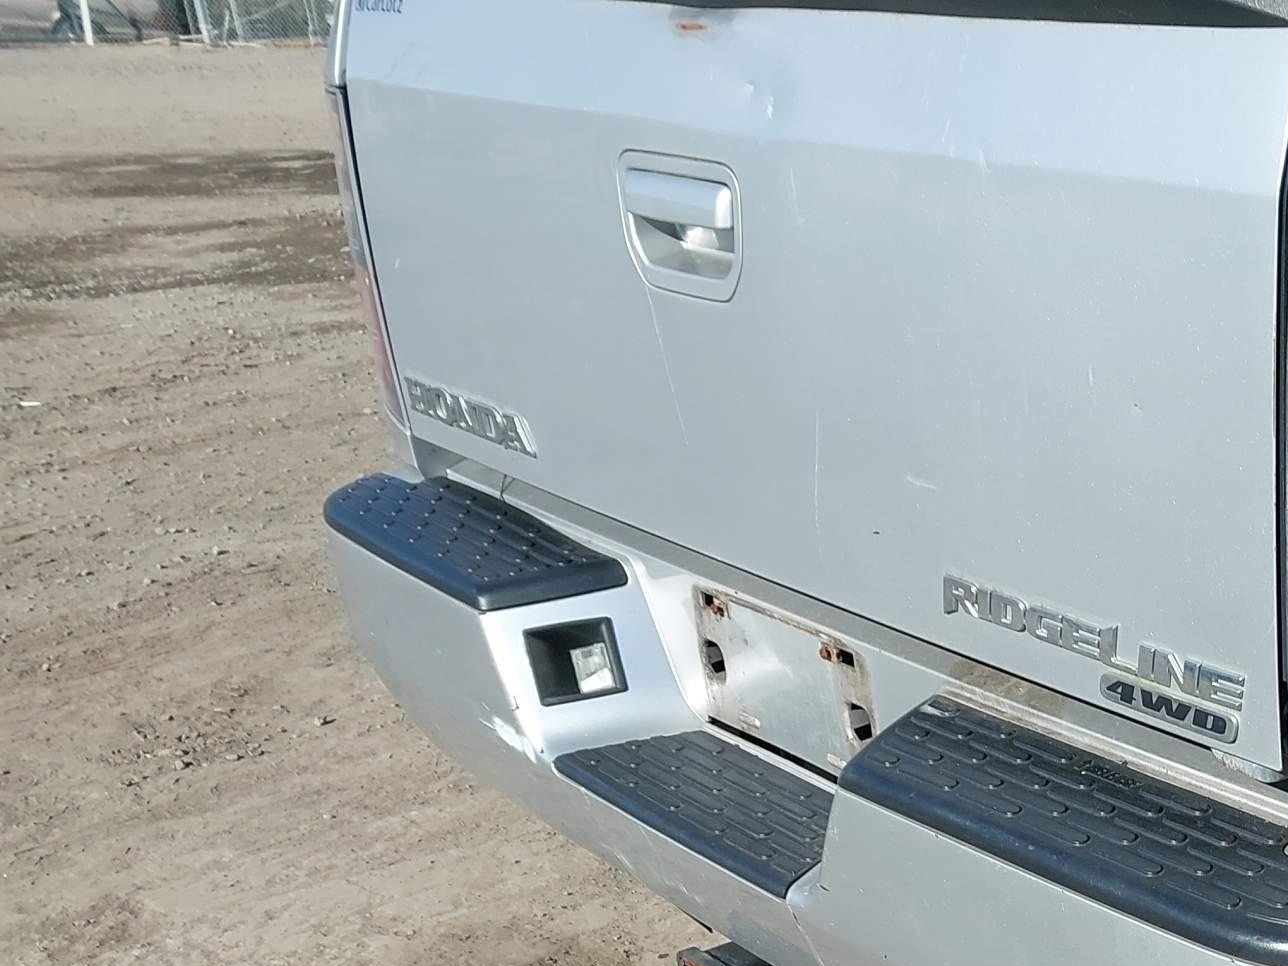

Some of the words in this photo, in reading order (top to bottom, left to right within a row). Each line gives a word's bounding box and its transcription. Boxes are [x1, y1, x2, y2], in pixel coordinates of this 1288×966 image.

[403, 375, 538, 459] HONDA
[943, 574, 1246, 712] RIDGELINE
[1104, 679, 1228, 736] 4WD
